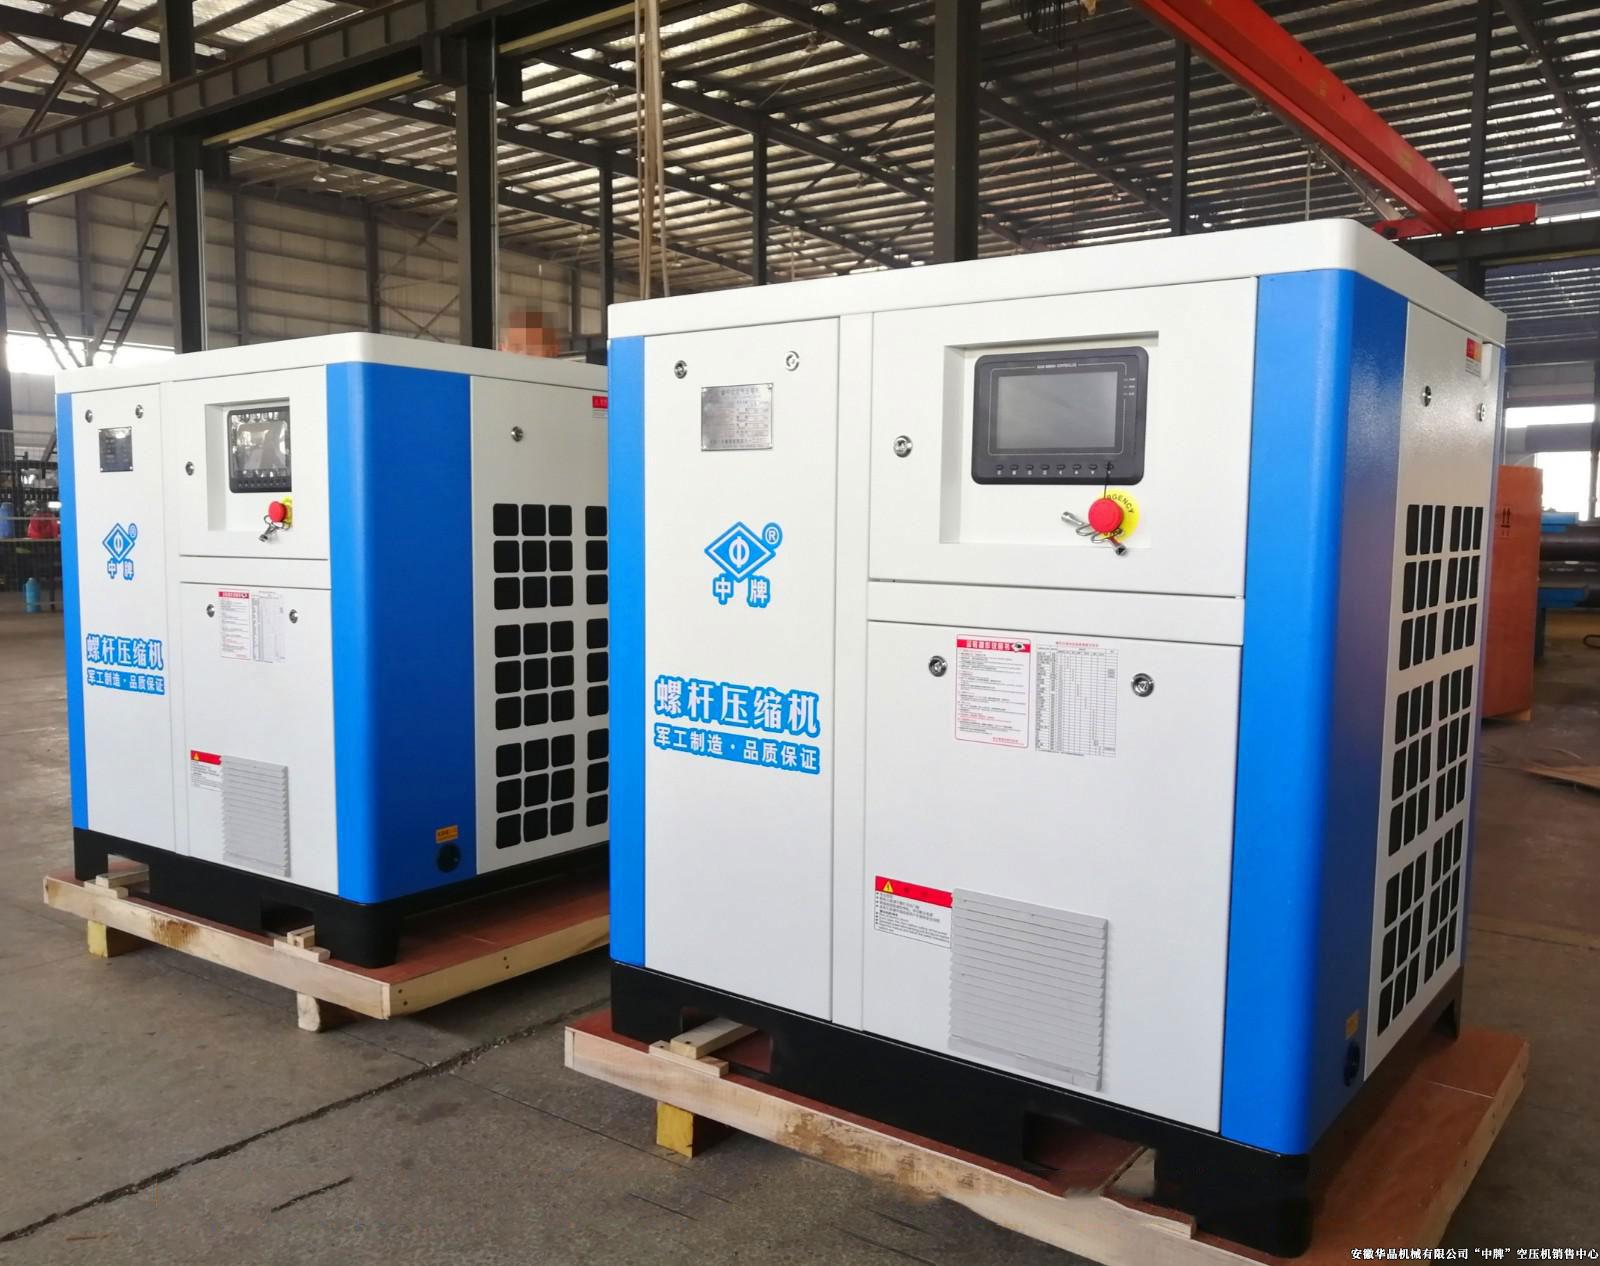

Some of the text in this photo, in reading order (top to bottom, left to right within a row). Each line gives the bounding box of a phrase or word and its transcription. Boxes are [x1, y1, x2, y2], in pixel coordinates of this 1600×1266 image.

[713, 574, 769, 606] 中牌
[87, 634, 163, 670] 螺杆压缩机
[655, 676, 820, 737] 螺杆压缩机
